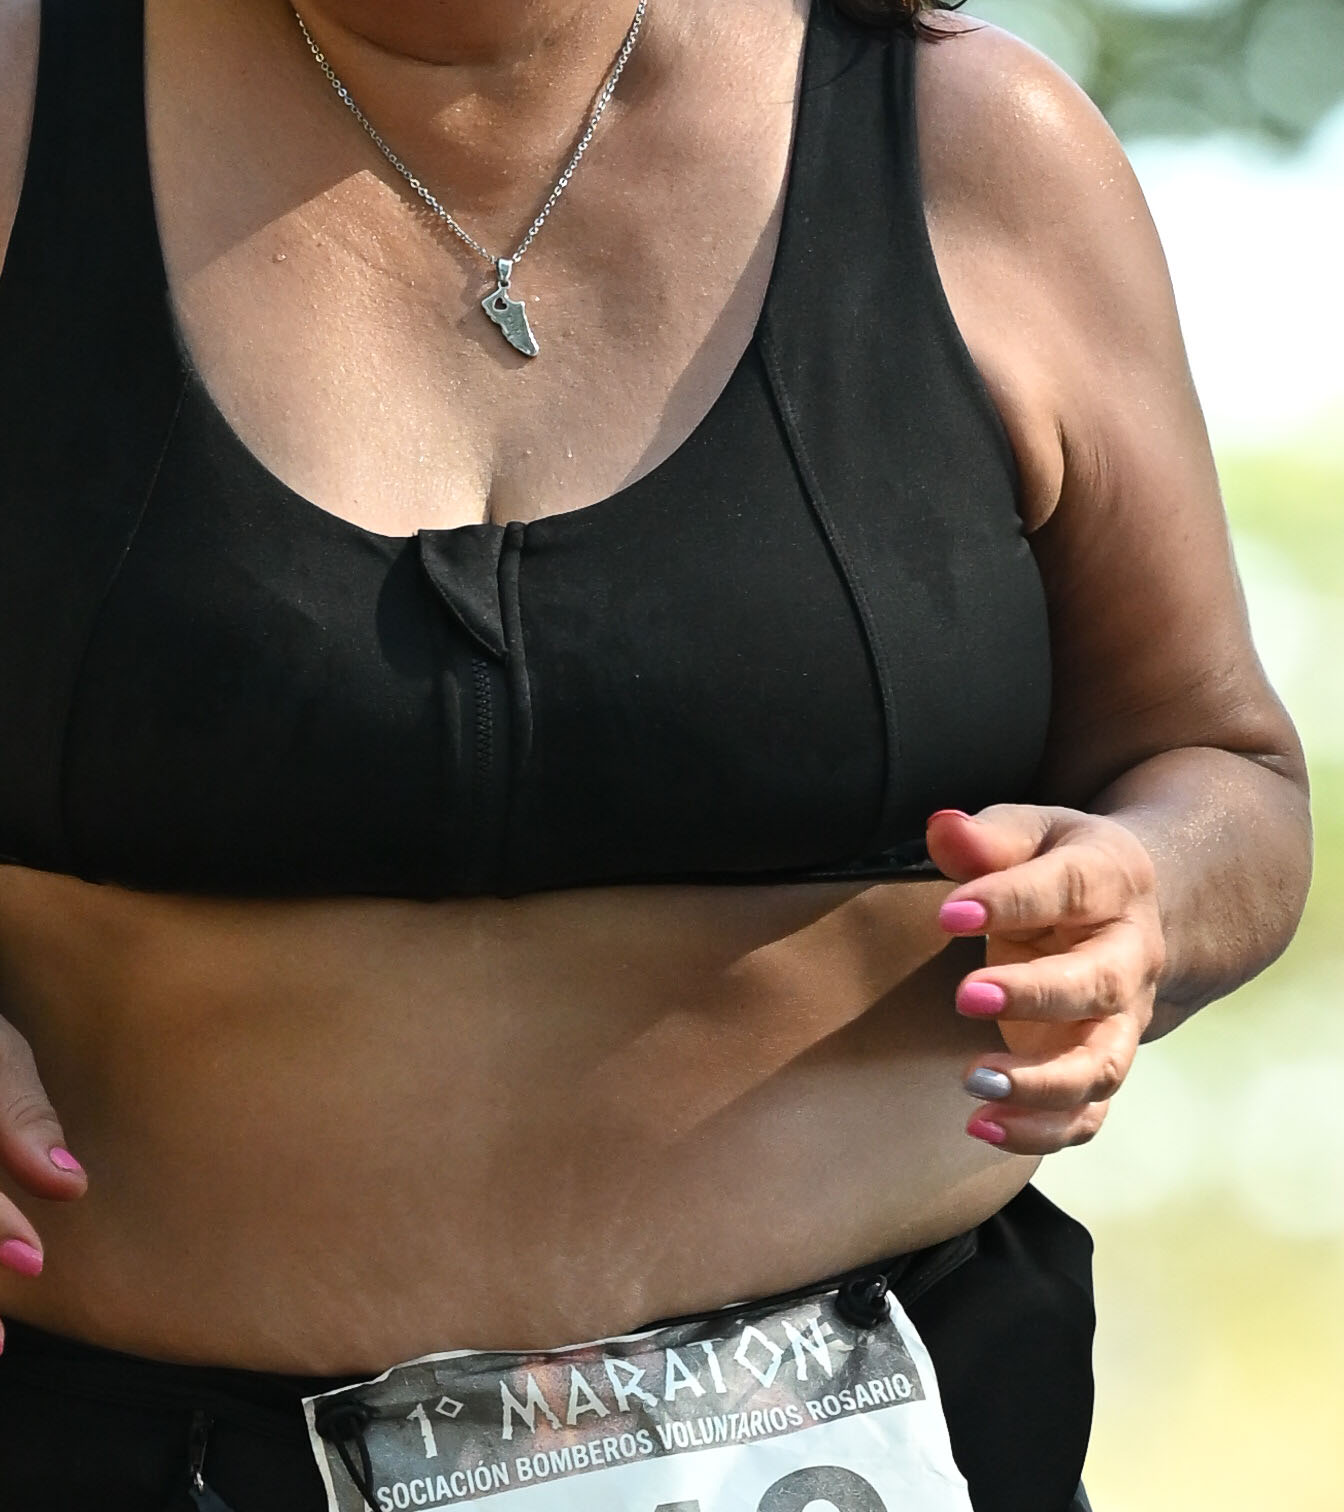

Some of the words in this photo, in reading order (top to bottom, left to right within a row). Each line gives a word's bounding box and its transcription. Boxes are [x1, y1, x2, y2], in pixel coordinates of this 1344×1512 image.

[515, 1428, 654, 1482] BOMBEROS
[656, 1404, 804, 1451] VOLUNTARIOS
[806, 1373, 914, 1422] ROSARIO
